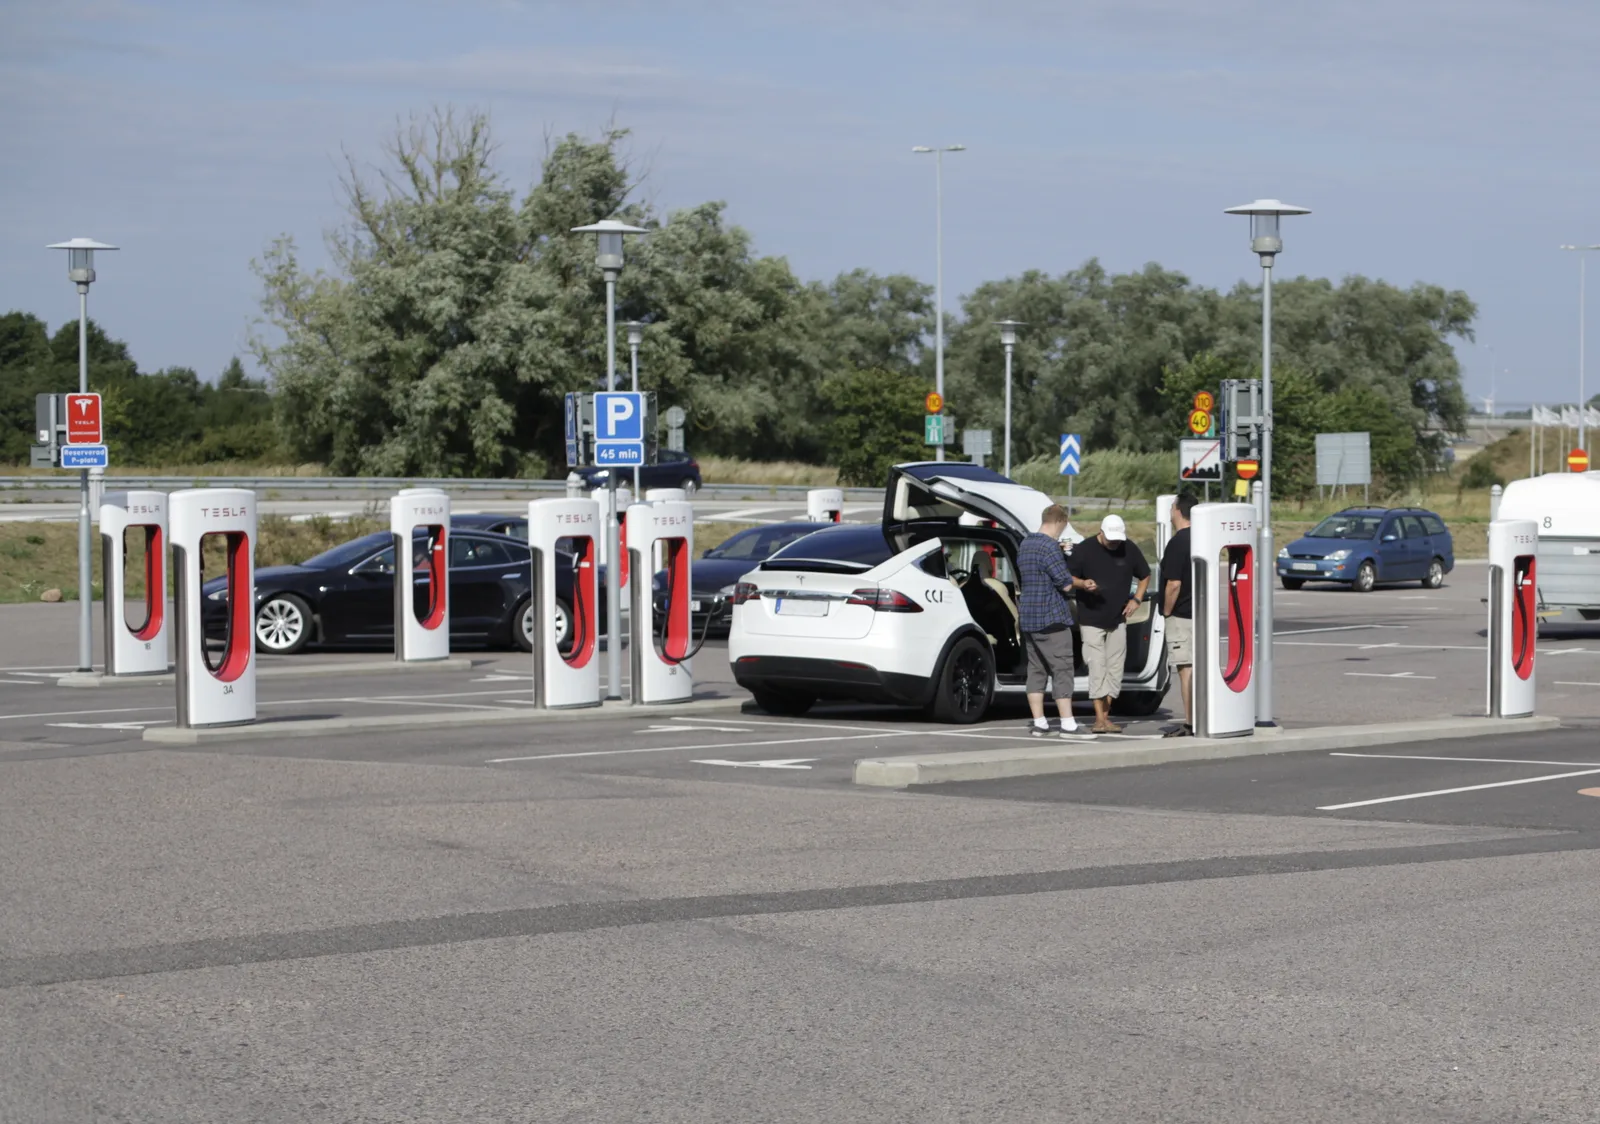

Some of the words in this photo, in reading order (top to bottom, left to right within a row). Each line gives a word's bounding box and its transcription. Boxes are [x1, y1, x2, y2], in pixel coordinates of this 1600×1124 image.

[607, 397, 634, 436] P
[1192, 415, 1208, 428] 40
[600, 448, 616, 459] 45
[618, 448, 638, 459] min
[124, 505, 160, 513] TESLA
[201, 507, 247, 517] TESLA
[413, 507, 444, 516] TESLA
[556, 513, 593, 523] TESLA
[653, 516, 687, 525] TESLA
[1543, 516, 1552, 529] 8
[1221, 521, 1252, 531] TESLA
[223, 685, 233, 695] 3A
